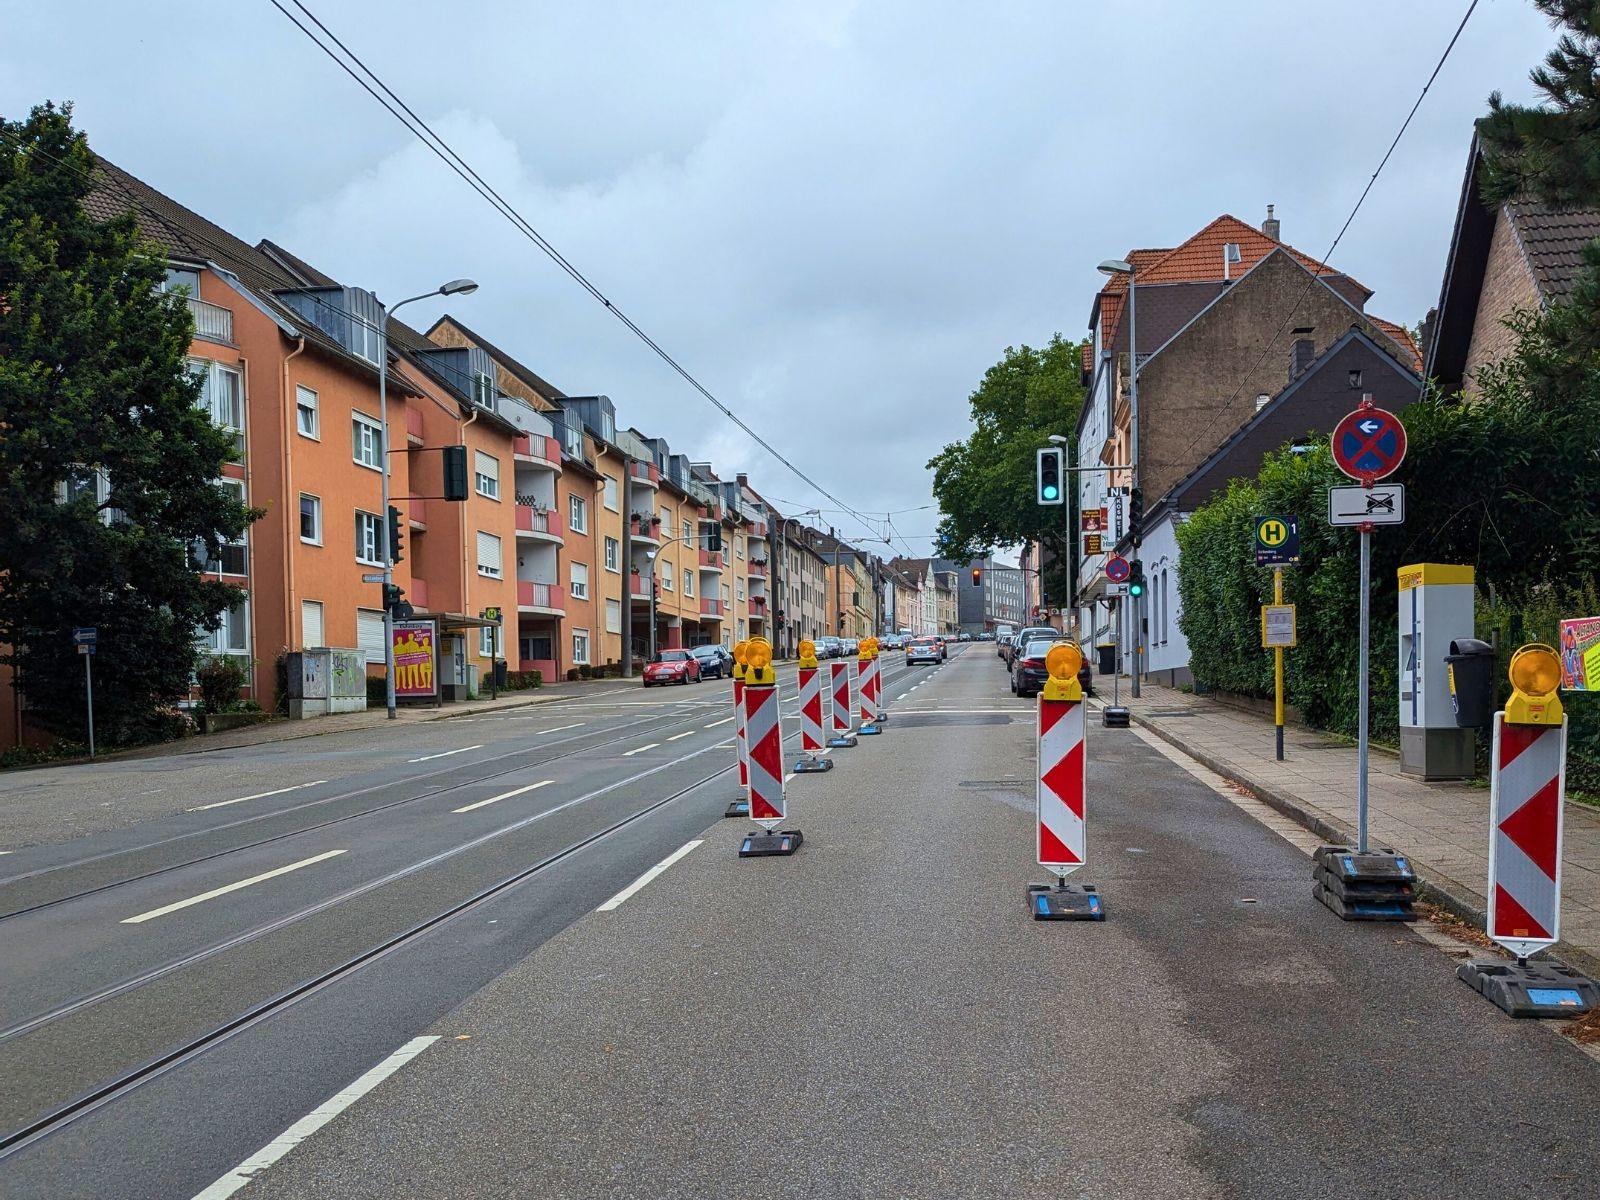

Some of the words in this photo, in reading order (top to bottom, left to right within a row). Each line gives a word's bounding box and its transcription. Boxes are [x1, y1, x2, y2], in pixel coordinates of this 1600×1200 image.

[1110, 487, 1128, 497] NL
[1265, 524, 1280, 541] H
[1291, 523, 1296, 534] 1
